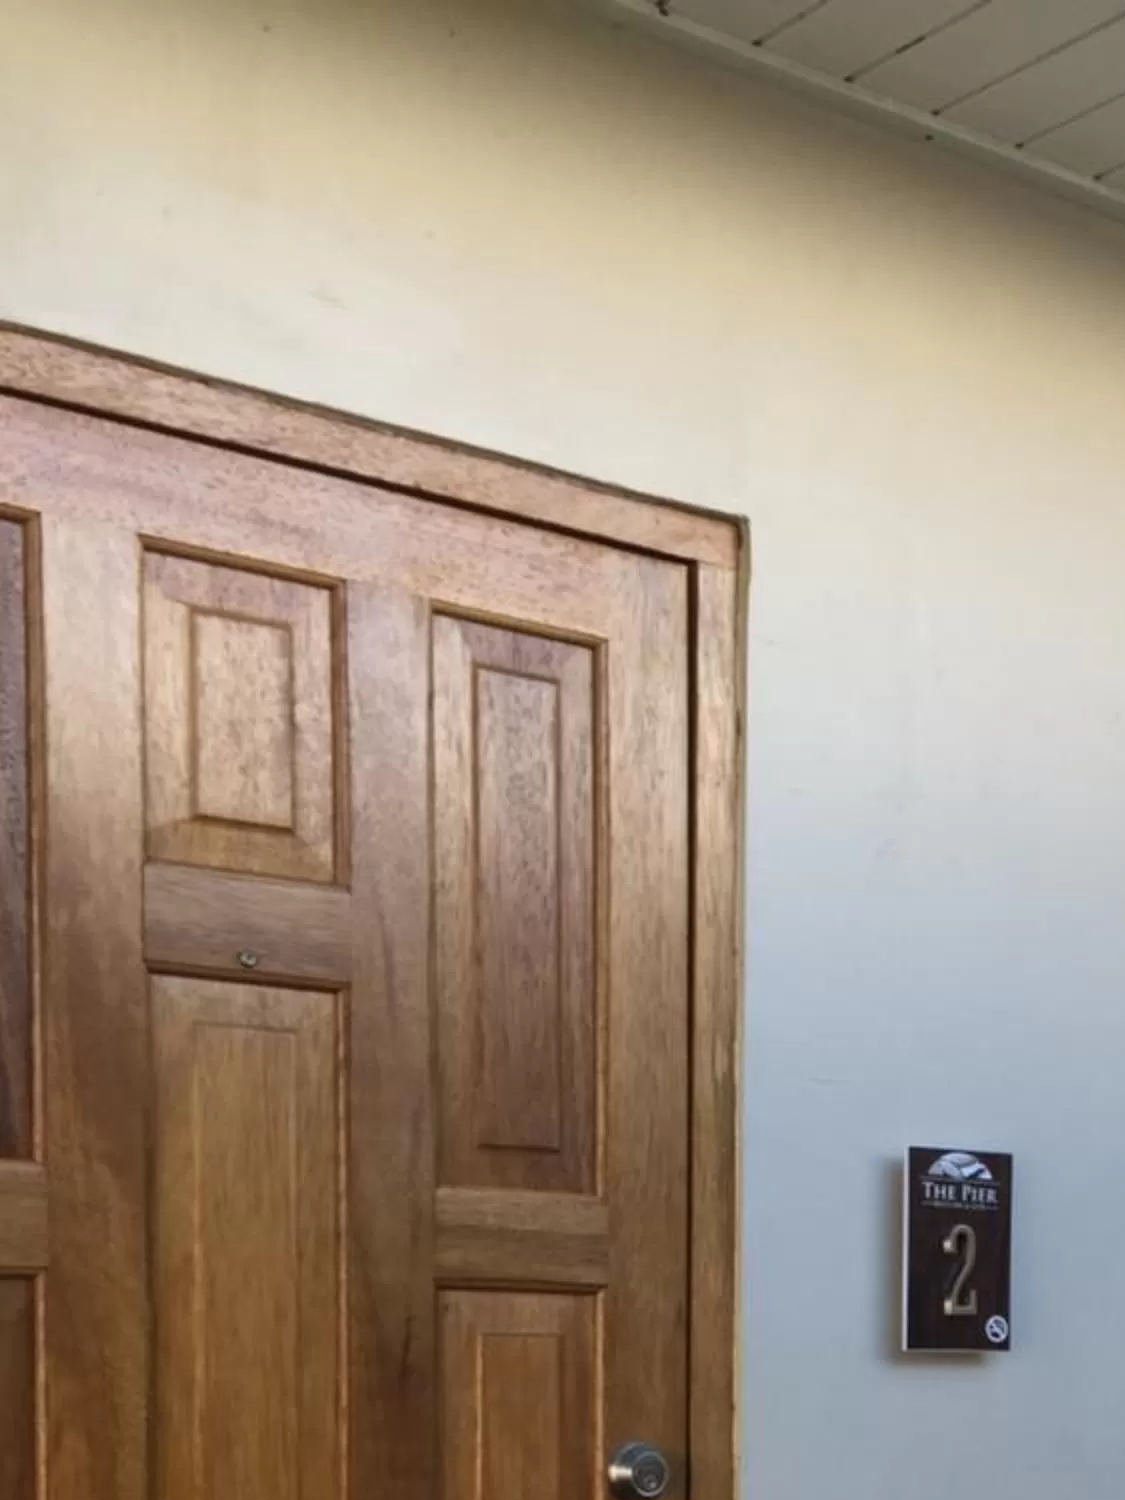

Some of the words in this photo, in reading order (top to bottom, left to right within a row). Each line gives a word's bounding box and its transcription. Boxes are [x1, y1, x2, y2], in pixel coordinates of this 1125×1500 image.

[921, 1181, 956, 1201] THE
[962, 1184, 999, 1203] PIER
[942, 1223, 978, 1316] 2
